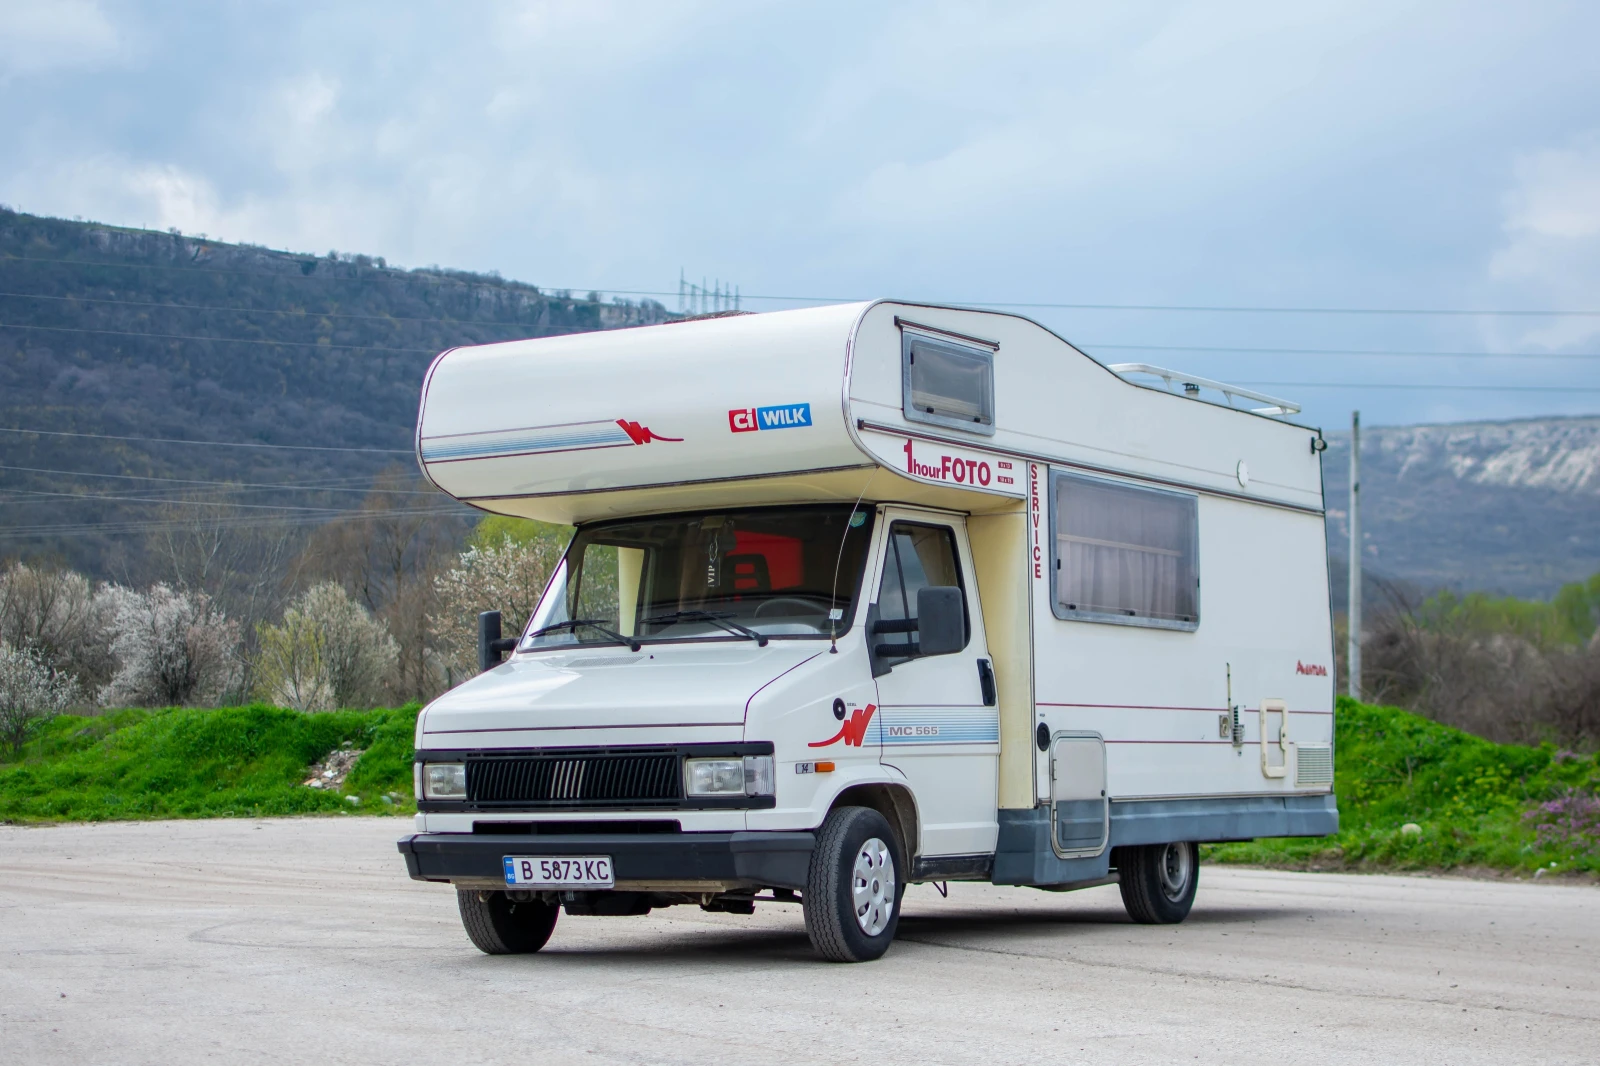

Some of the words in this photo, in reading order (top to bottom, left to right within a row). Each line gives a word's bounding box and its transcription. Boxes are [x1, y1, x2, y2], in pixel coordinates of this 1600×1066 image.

[762, 407, 806, 426] WILK
[1030, 463, 1042, 579] SERVICE
[707, 565, 715, 584] VIP
[889, 726, 913, 736] MC
[915, 726, 938, 735] 565
[521, 860, 533, 880] B
